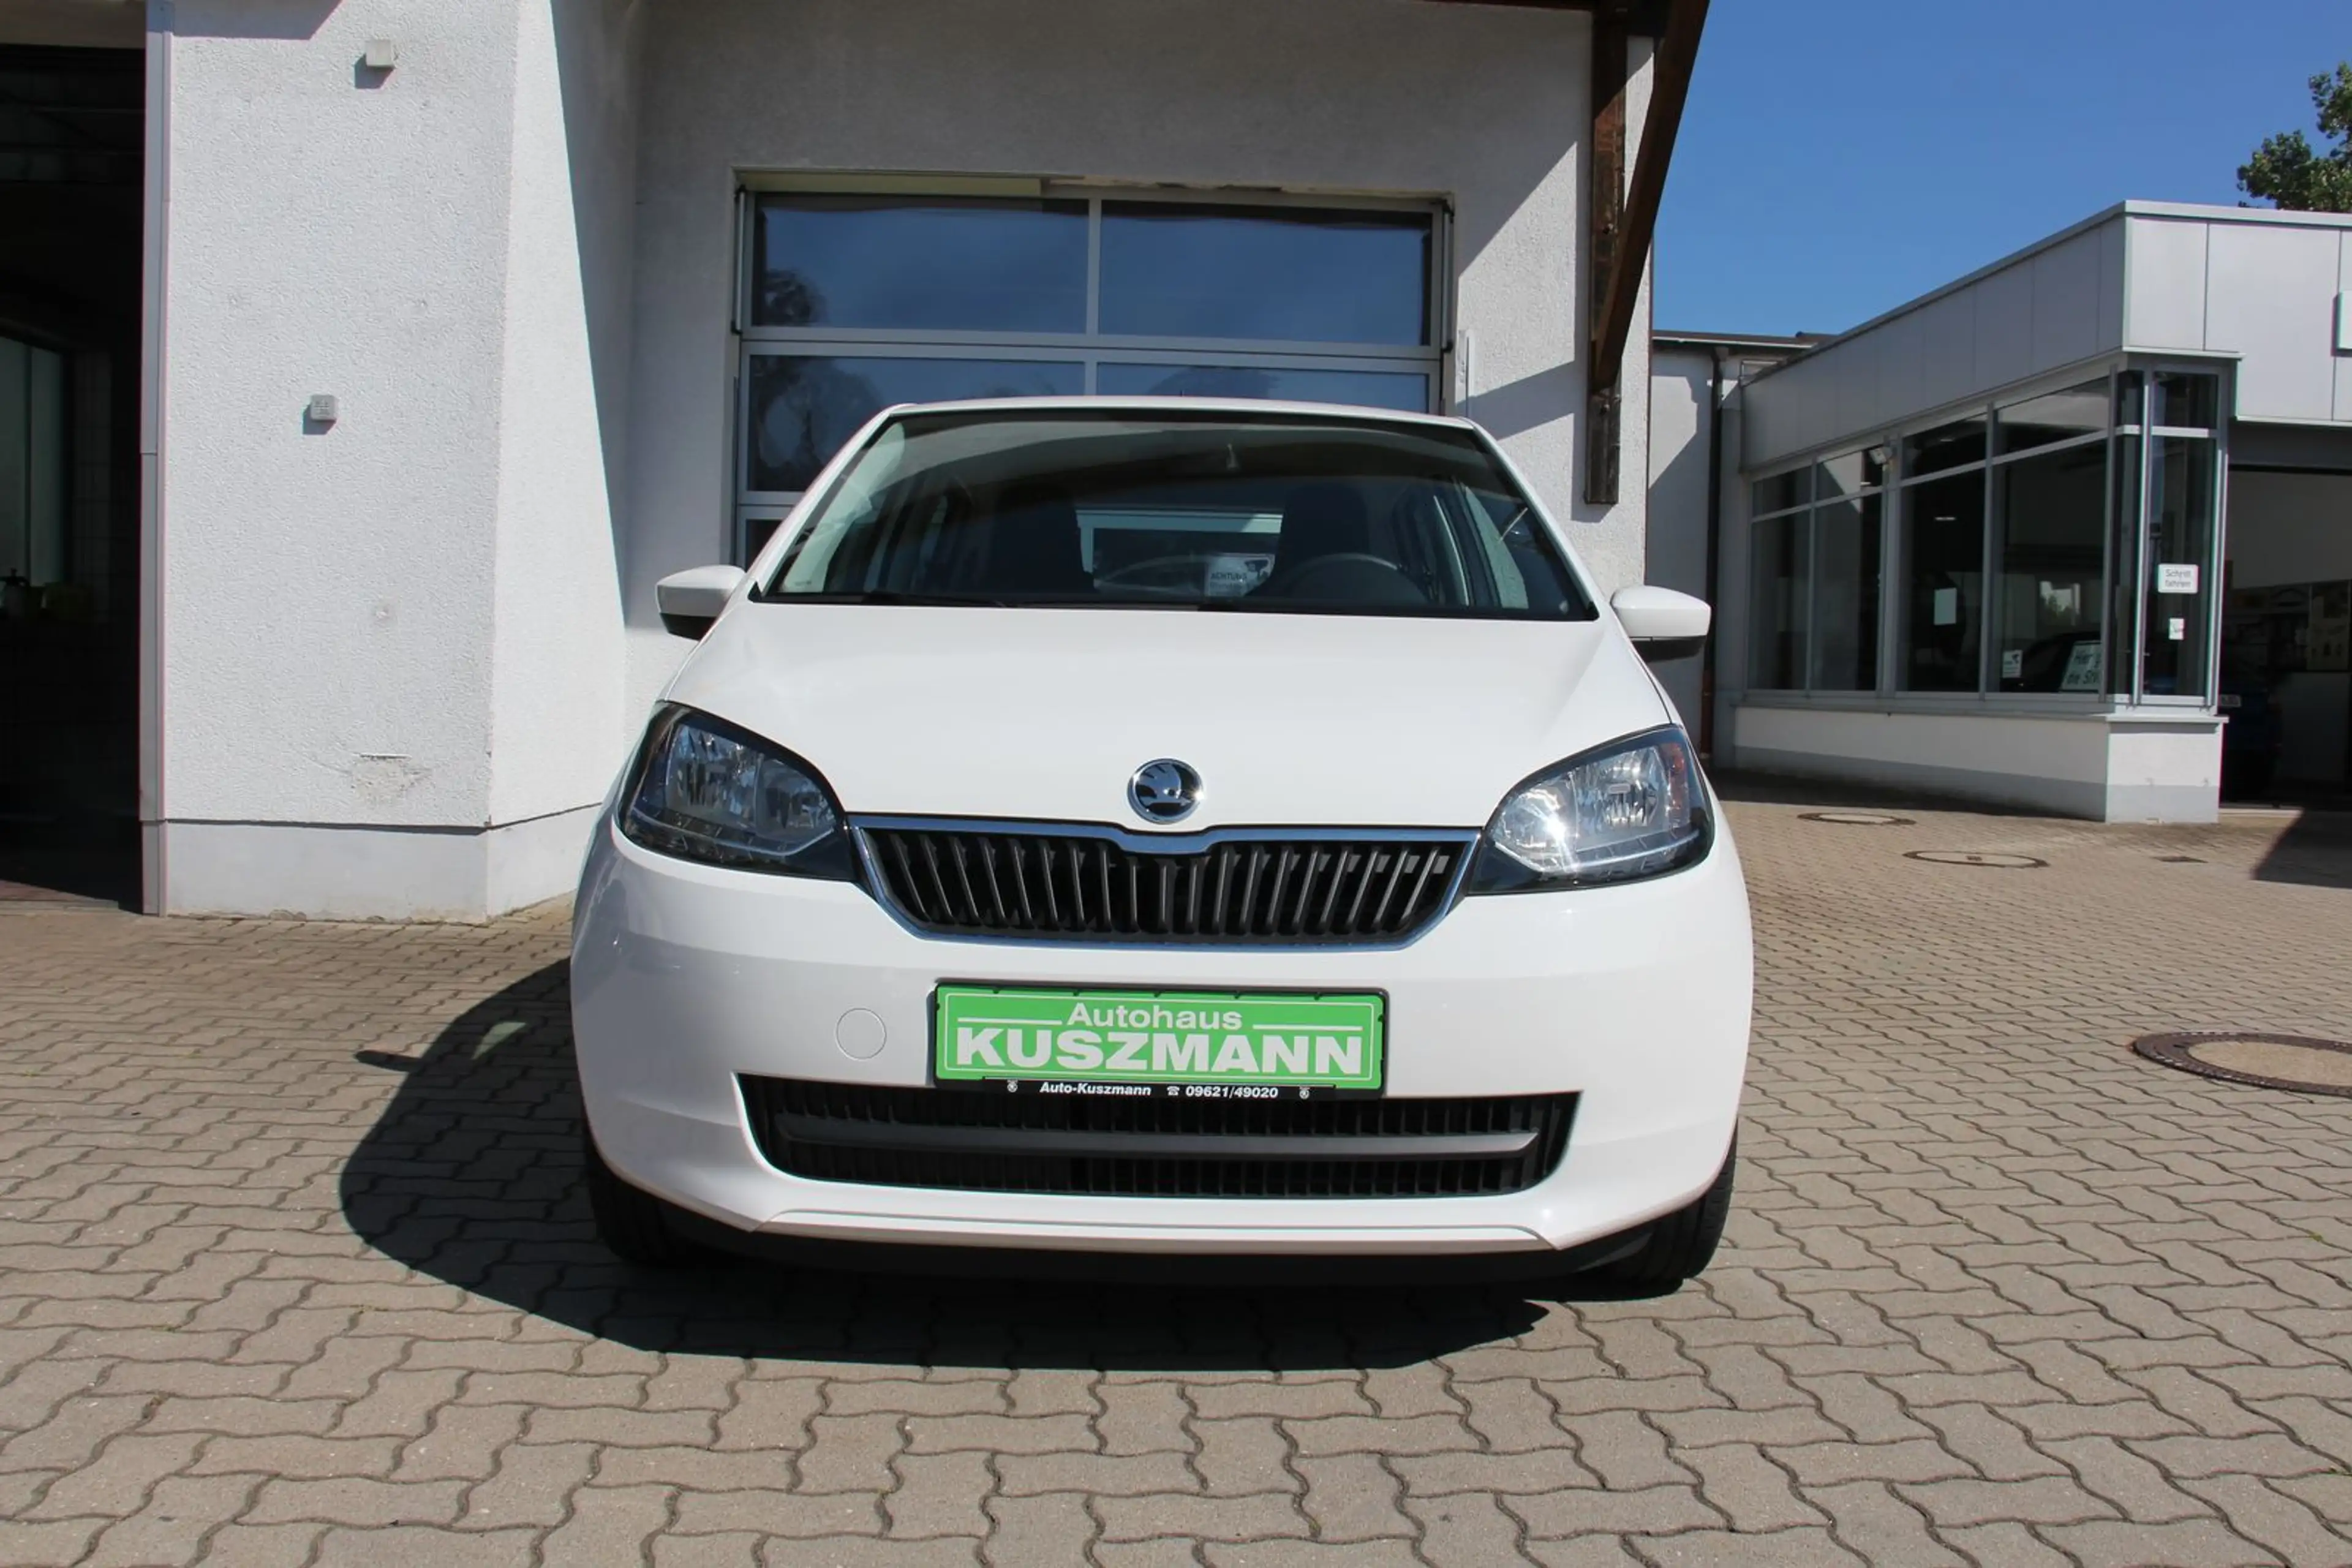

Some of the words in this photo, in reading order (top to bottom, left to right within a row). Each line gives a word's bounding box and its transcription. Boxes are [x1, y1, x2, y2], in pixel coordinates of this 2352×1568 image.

[1066, 1002, 1243, 1031] Autohaus
[956, 1027, 1363, 1076] KUSZMANN
[1039, 1081, 1152, 1096] Auto-Kuszmann
[1185, 1085, 1279, 1099] 09621/49020
